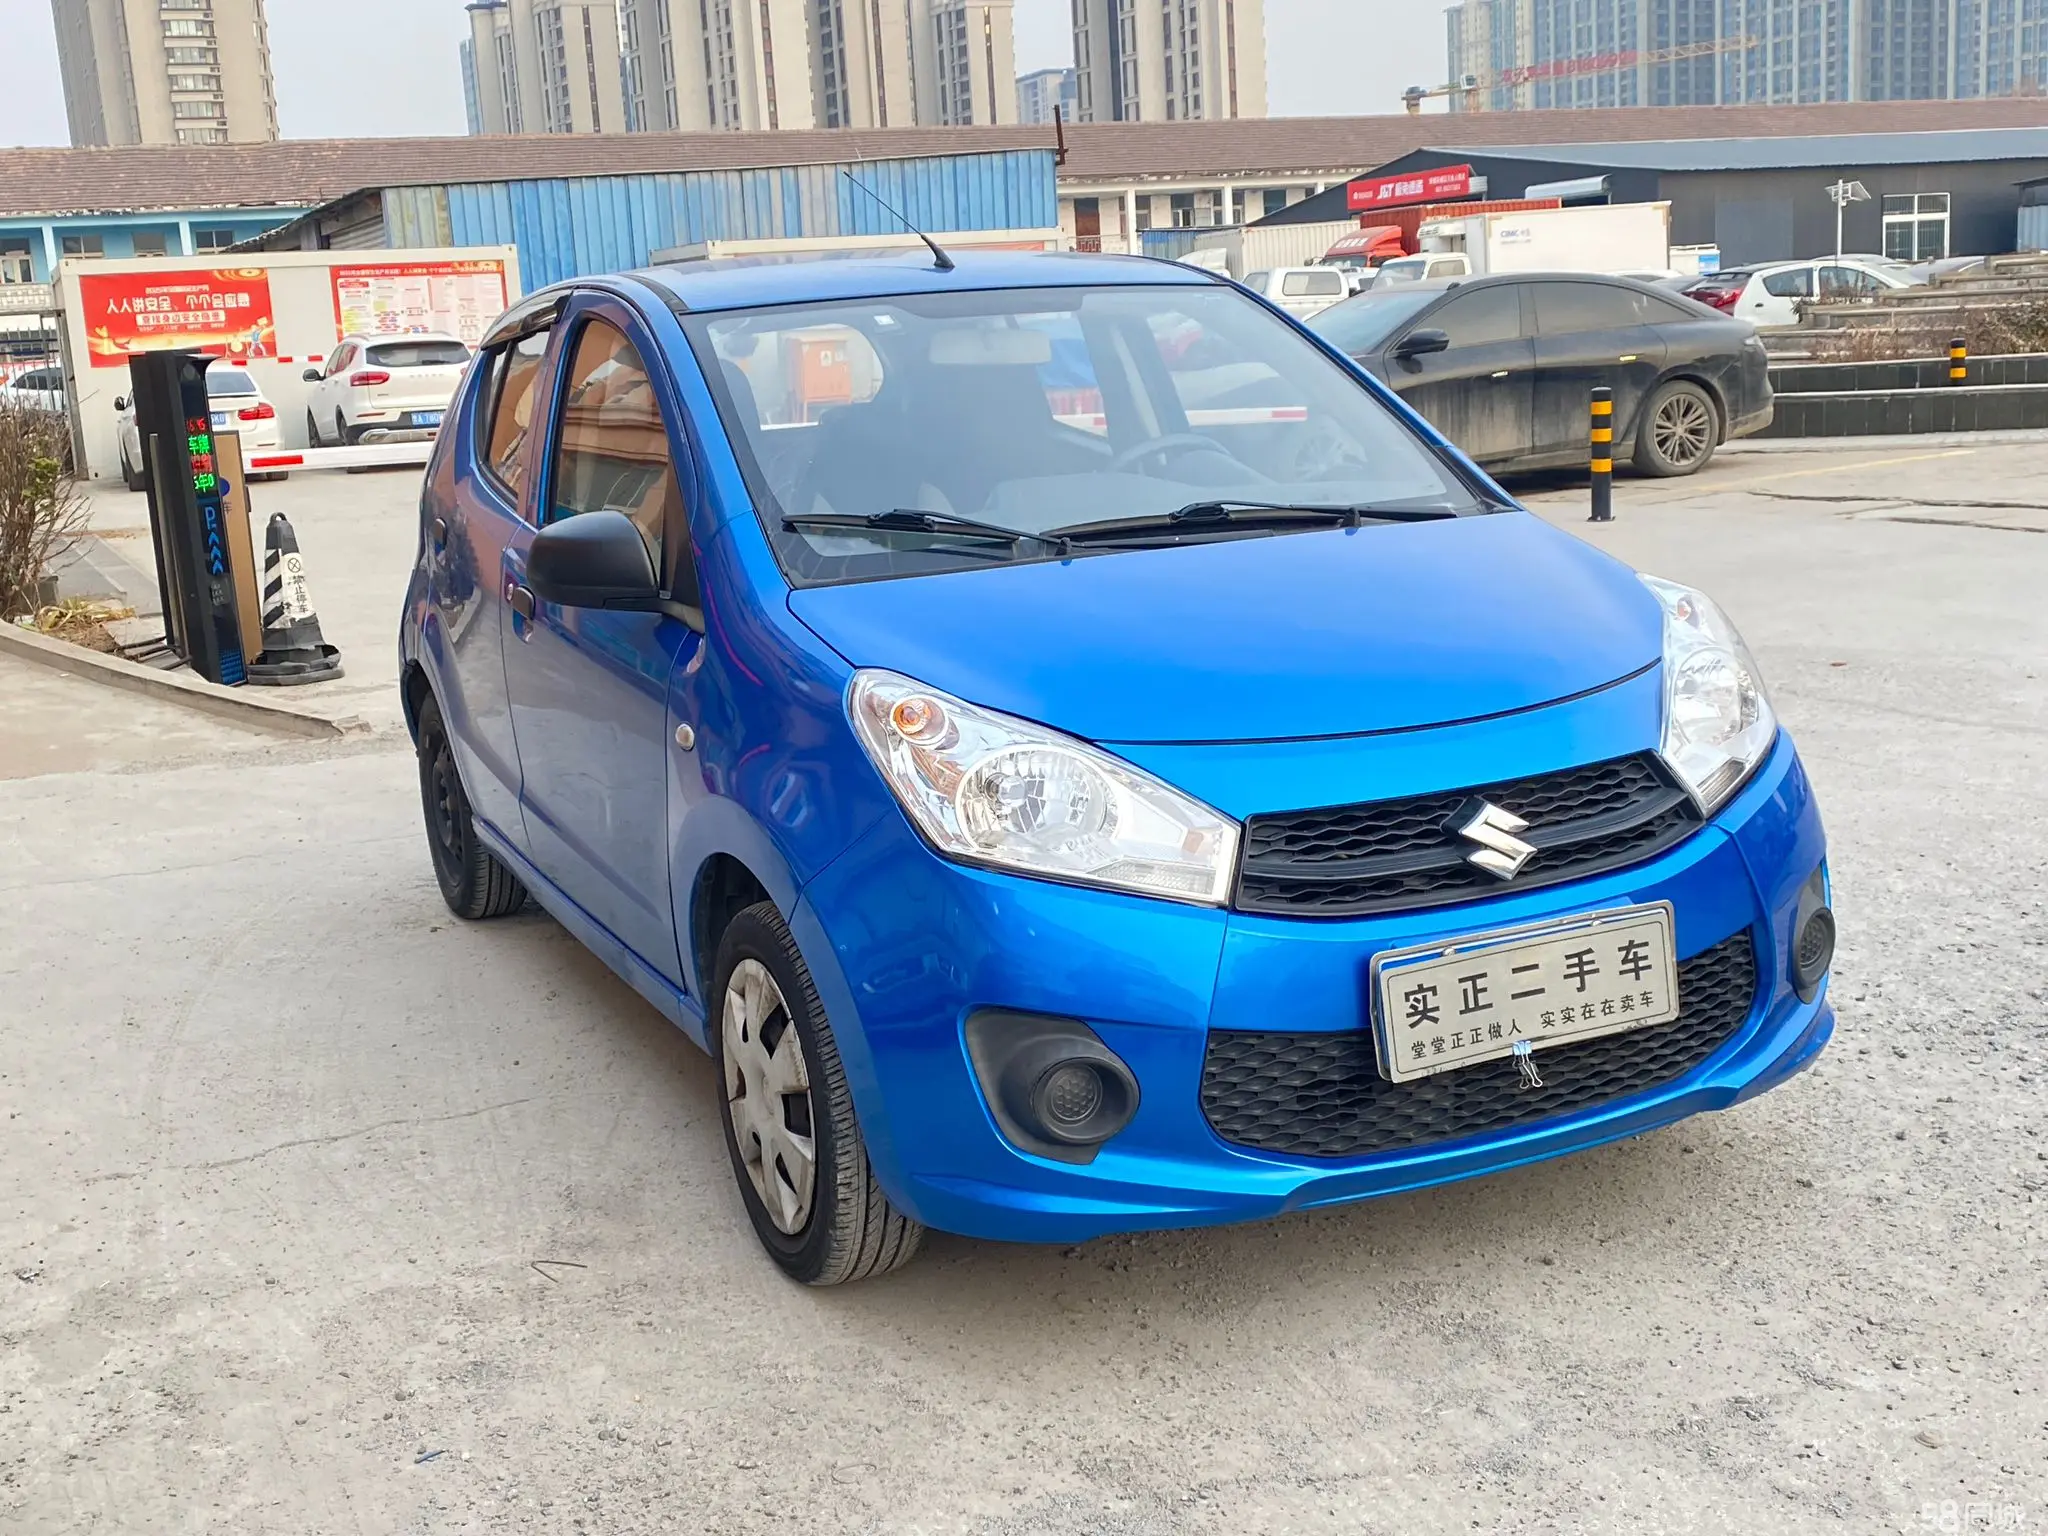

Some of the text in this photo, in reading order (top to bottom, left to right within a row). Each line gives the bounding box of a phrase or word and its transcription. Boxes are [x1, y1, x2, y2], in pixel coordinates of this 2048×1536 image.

[1403, 939, 1653, 1029] 实正二手车
[1411, 990, 1655, 1060] 堂堂正正做人 实实在在卖车
